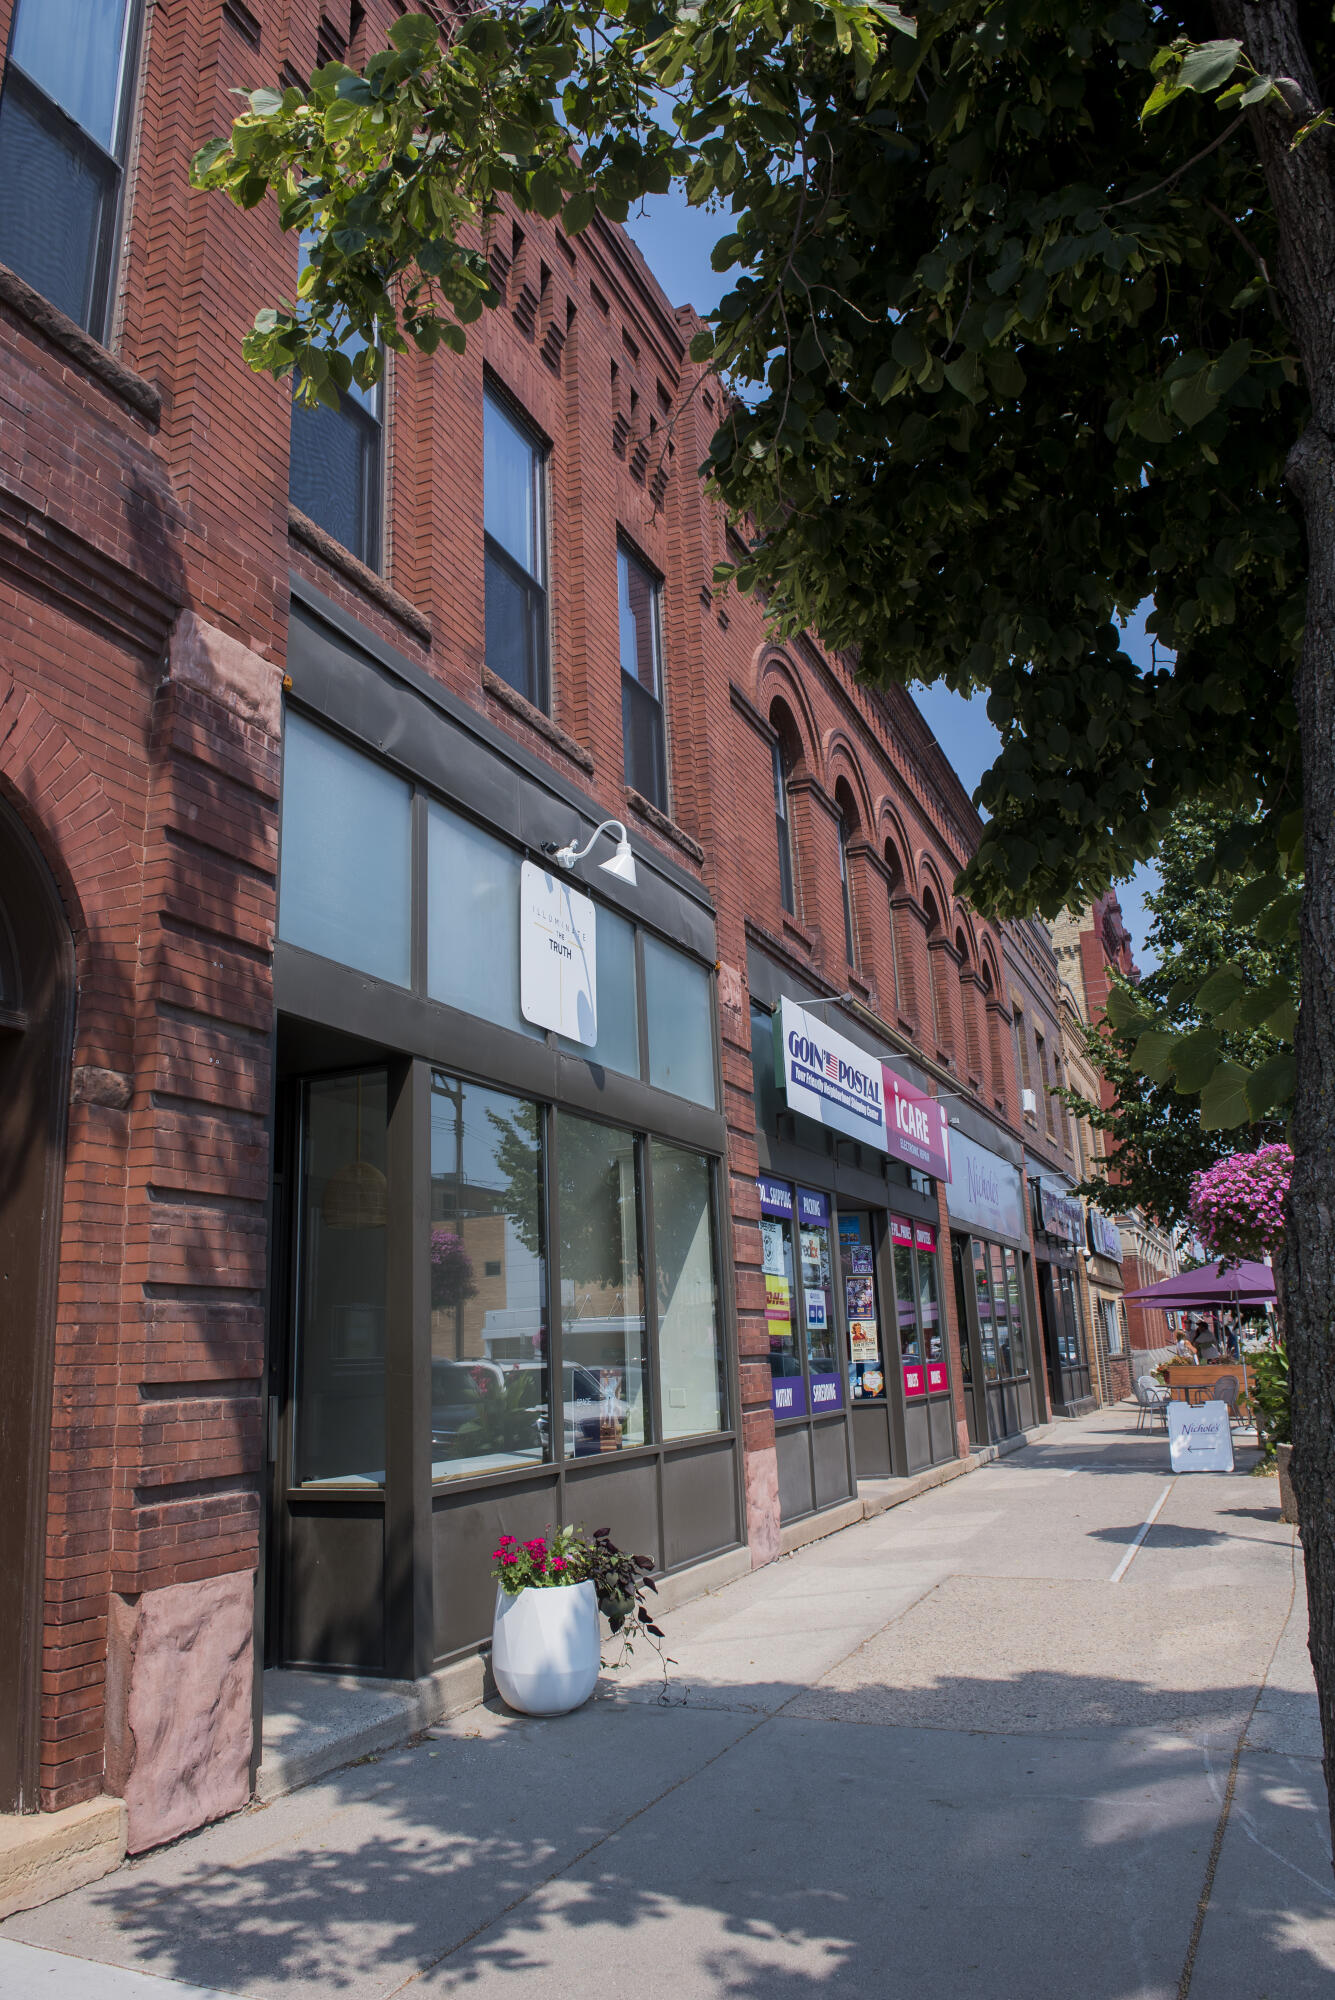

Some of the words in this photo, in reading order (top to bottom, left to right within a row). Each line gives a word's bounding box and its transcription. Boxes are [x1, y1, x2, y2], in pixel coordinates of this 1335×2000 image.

[556, 930, 565, 940] THE
[549, 938, 571, 960] TRUTH
[838, 1059, 882, 1106] POSTAL
[893, 1080, 930, 1145] iCARE
[803, 1197, 820, 1216] PACKING
[775, 1388, 792, 1408] NOTARY
[813, 1382, 837, 1403] SHREDDING
[1181, 1422, 1220, 1436] Nichole's
